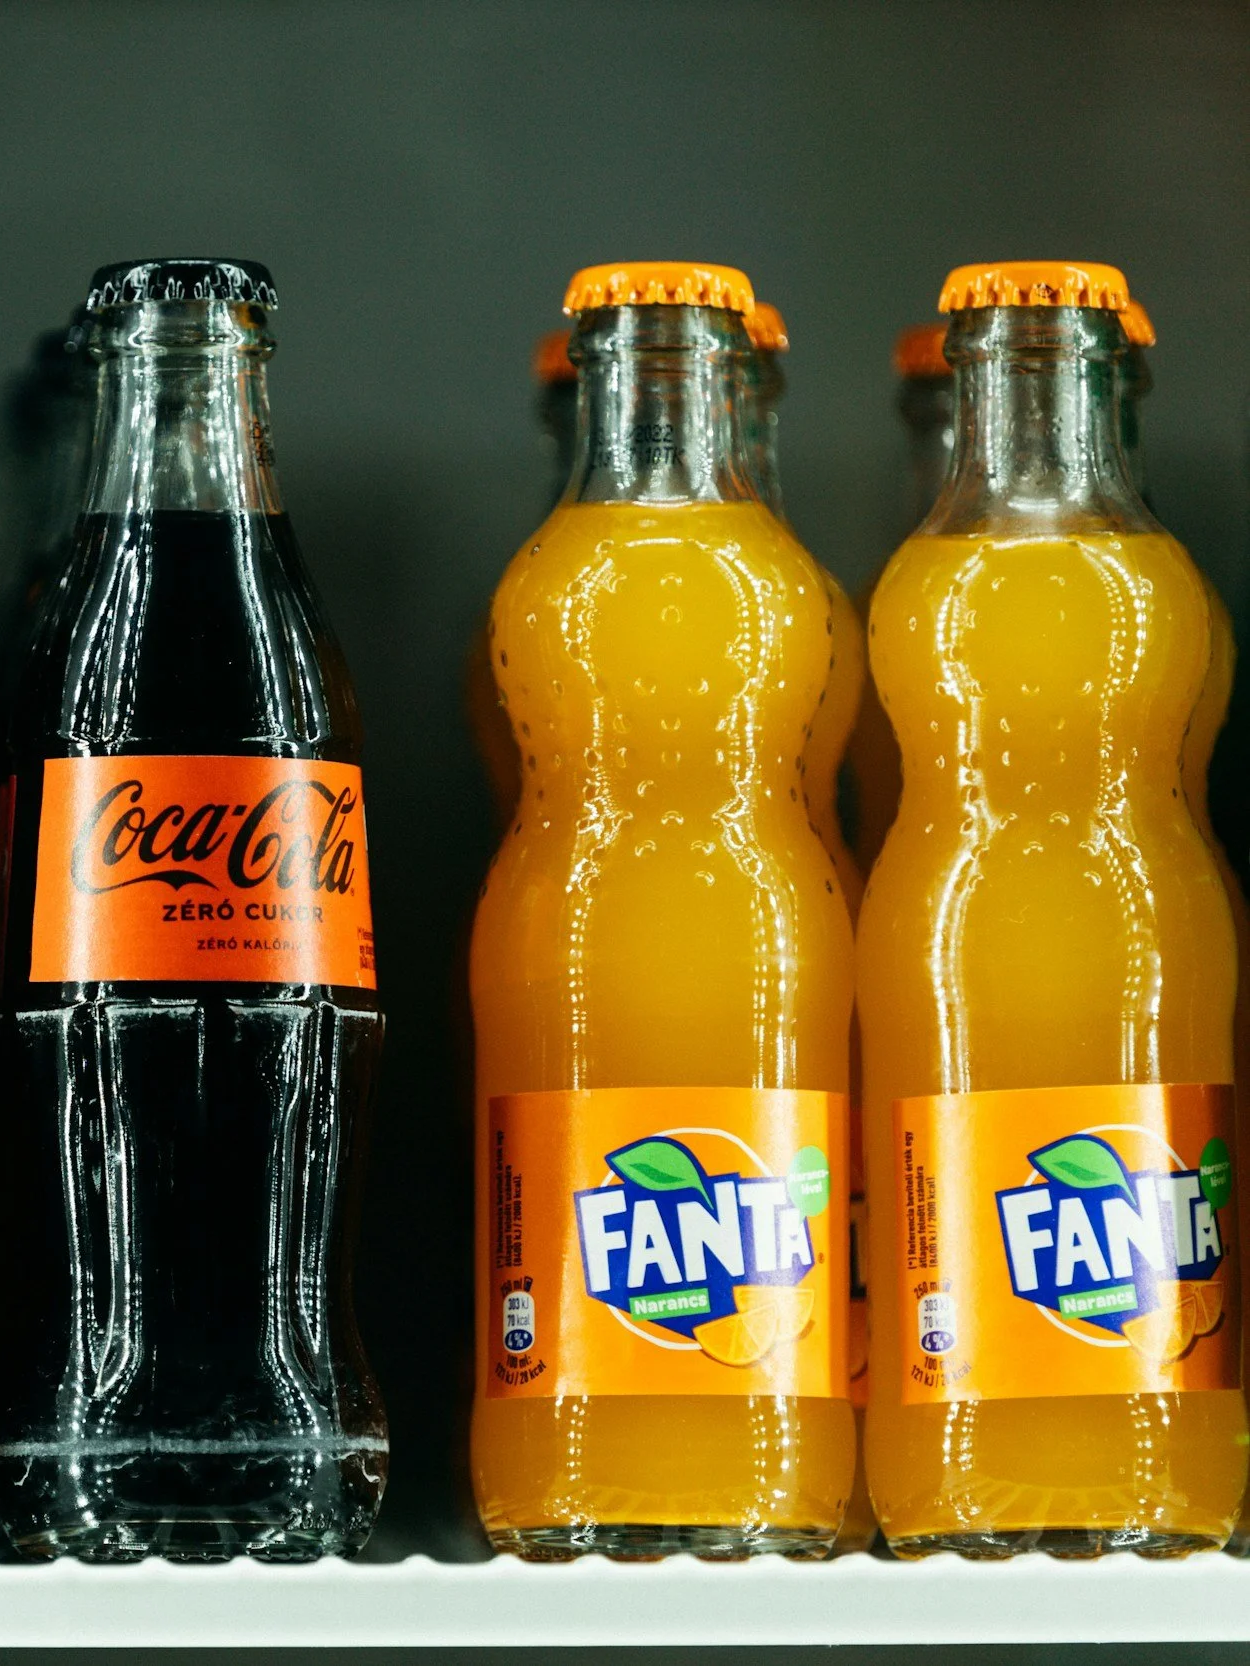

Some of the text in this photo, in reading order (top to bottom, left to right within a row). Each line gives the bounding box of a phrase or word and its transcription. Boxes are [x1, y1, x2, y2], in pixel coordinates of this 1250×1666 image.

[71, 779, 358, 896] Coca-Cola
[162, 899, 324, 923] ZÉRÓ CUKOR
[197, 936, 238, 951] ZÉRÓ
[904, 1130, 914, 1147] egy
[904, 1149, 913, 1172] érték
[905, 1174, 915, 1207] beviteli
[916, 1166, 925, 1203] számára
[579, 1181, 812, 1293] FANTA
[906, 1208, 916, 1255] Referencia
[1001, 1175, 1221, 1293] FANTA
[918, 1236, 928, 1269] átlagos
[914, 1281, 928, 1300] 250
[508, 1296, 530, 1311] 303 kJ
[634, 1294, 708, 1315] Narancs
[924, 1299, 938, 1312] 303
[1063, 1291, 1134, 1314] Narancs
[516, 1314, 531, 1326] kcal
[924, 1316, 933, 1329] 70
[529, 1359, 547, 1381] kcal
[924, 1356, 938, 1371] 100
[911, 1365, 924, 1383] 121
[924, 1372, 934, 1387] kJ
